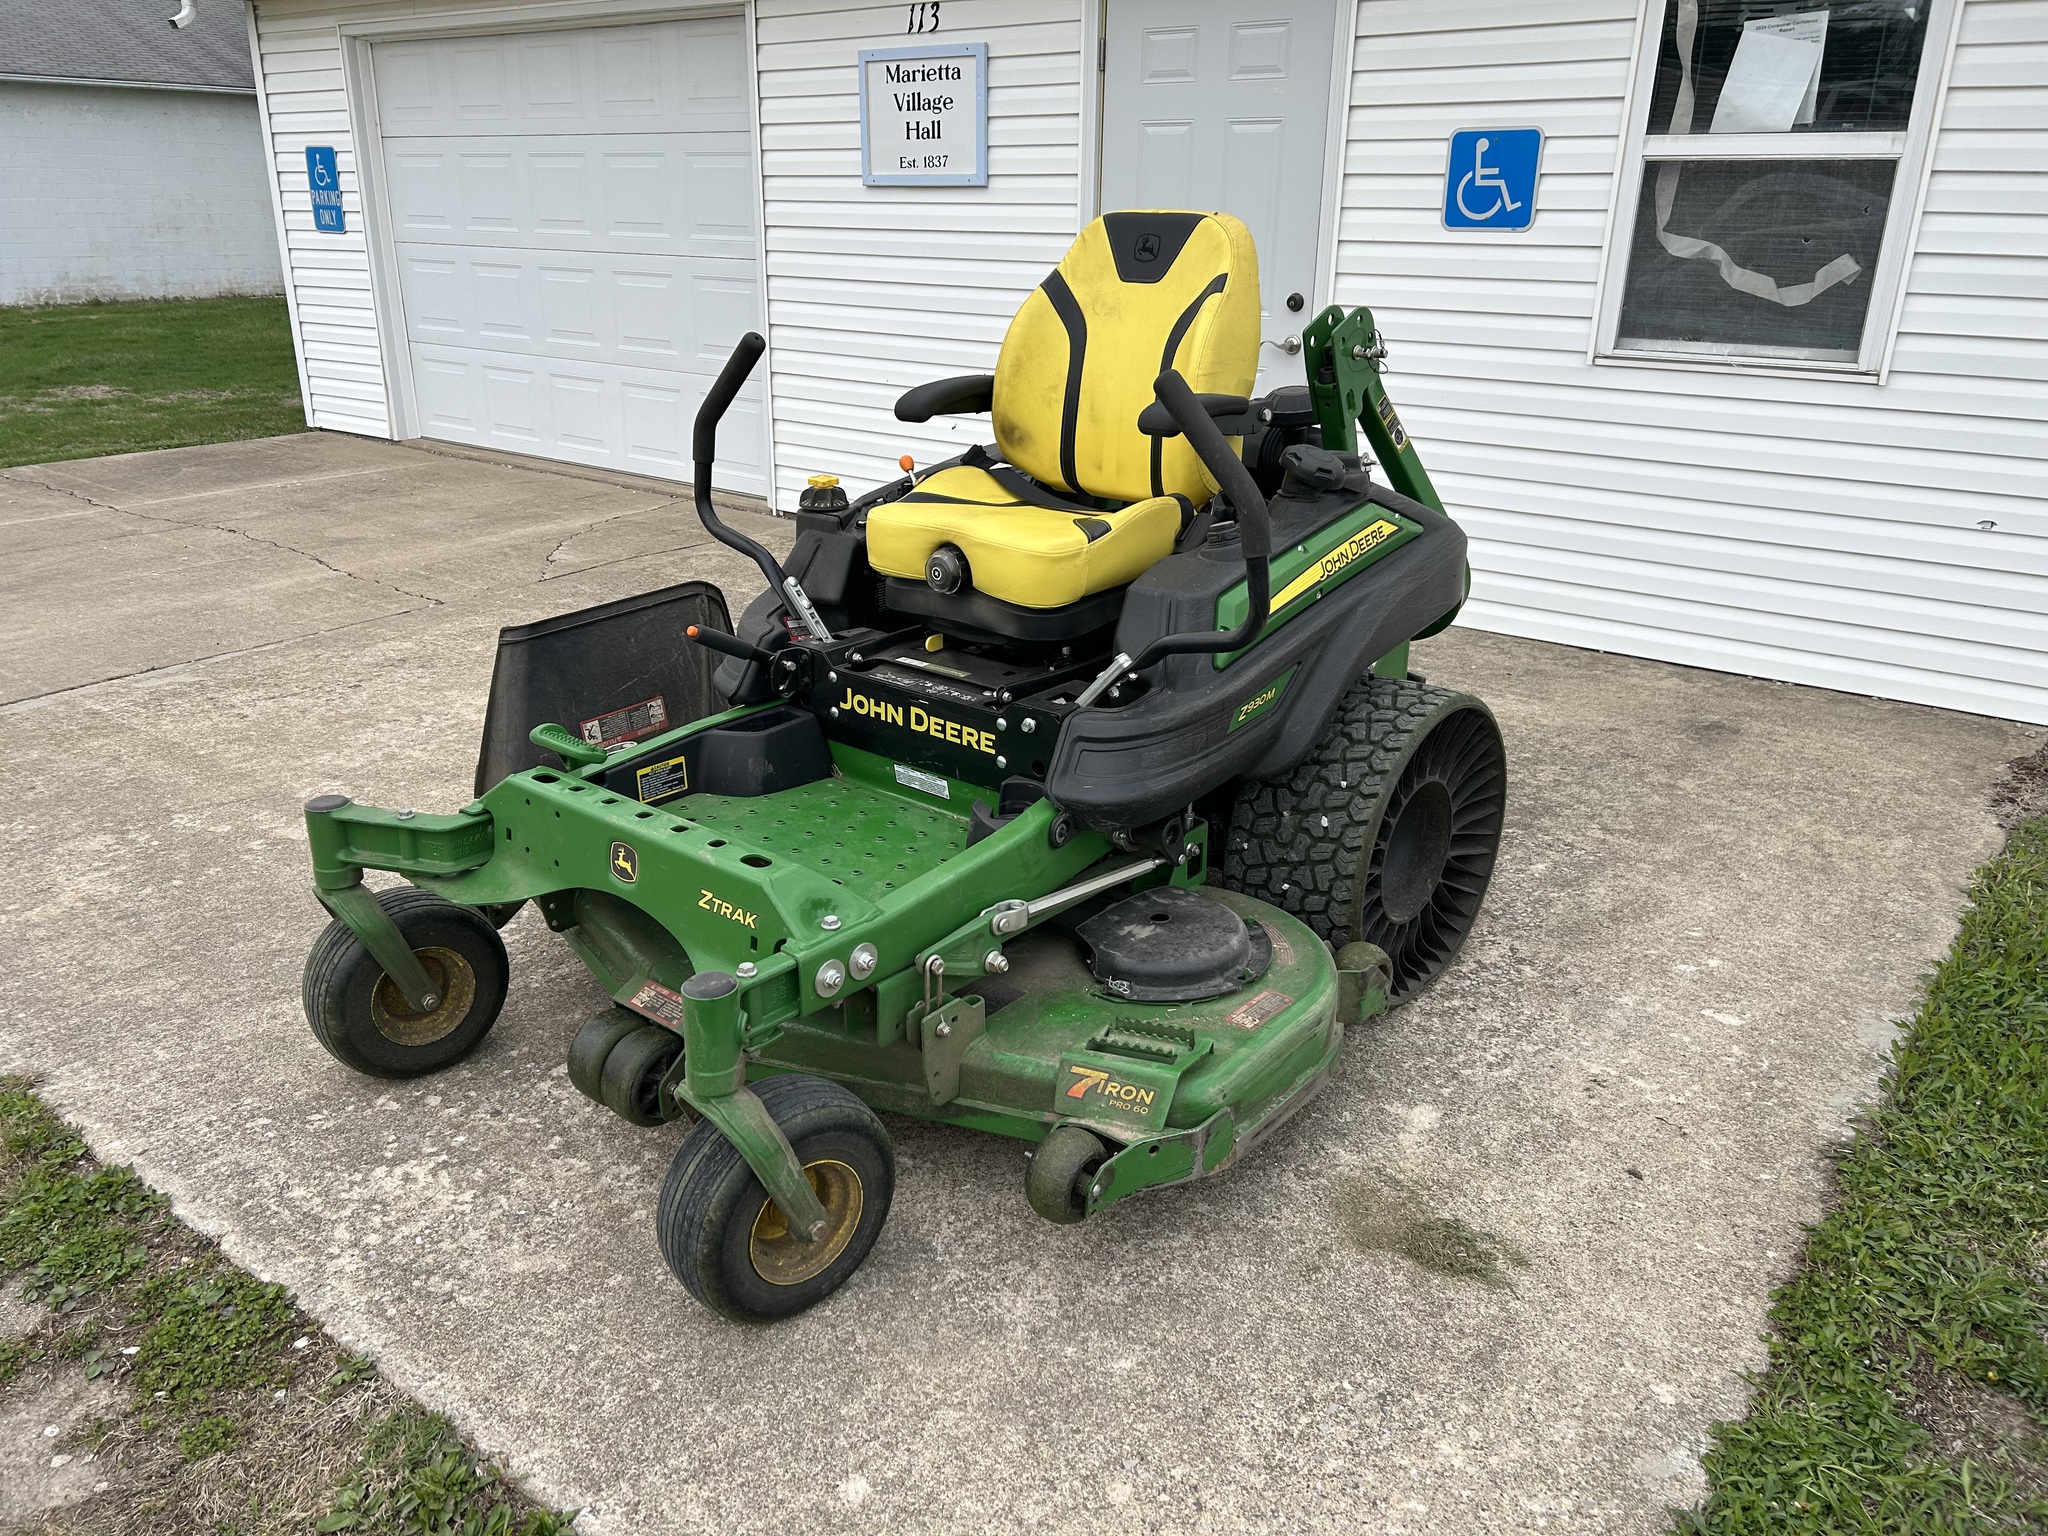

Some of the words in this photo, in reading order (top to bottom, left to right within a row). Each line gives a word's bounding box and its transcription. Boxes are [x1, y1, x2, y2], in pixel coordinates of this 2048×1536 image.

[907, 2, 940, 34] 113
[885, 63, 962, 84] Marietta
[893, 91, 954, 115] Village
[905, 119, 942, 140] Hall
[899, 156, 919, 169] Est.
[923, 155, 949, 169] 1837
[311, 190, 341, 207] PARKING
[319, 209, 337, 225] ONLY
[1319, 548, 1350, 579] JOHN
[1349, 525, 1385, 557] DEERE
[1237, 687, 1277, 722] Z930M
[839, 687, 904, 727] JOHN
[910, 706, 997, 755] DEERE
[697, 888, 759, 930] ZTRAK
[1108, 1099, 1132, 1112] PRO
[1133, 1105, 1150, 1116] 60
